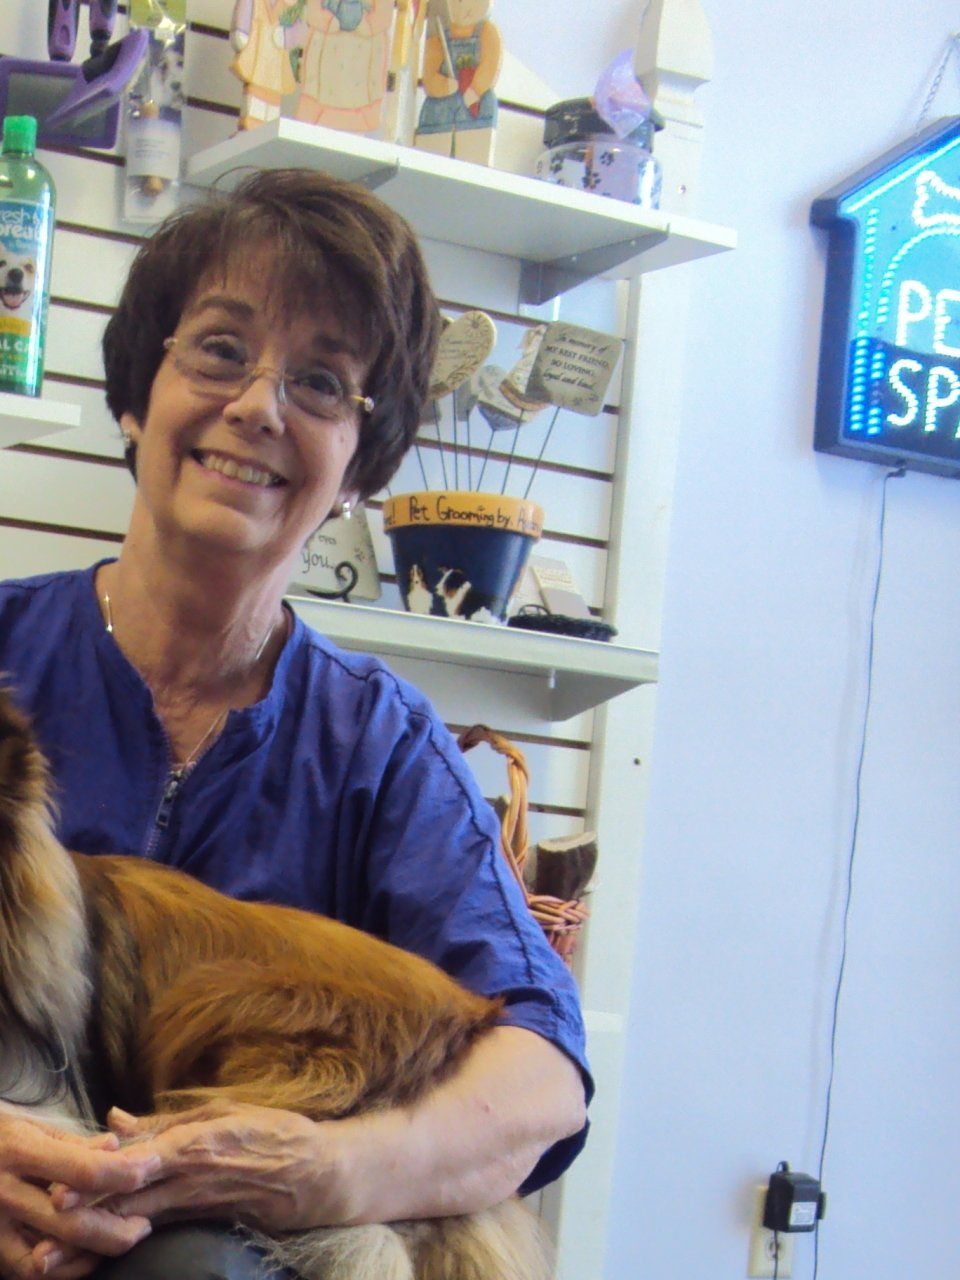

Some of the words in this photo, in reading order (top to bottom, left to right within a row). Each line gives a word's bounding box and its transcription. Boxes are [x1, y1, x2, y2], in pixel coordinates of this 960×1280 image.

[559, 348, 577, 358] BEST
[888, 360, 960, 439] SP
[408, 496, 433, 522] Pet
[436, 495, 496, 527] Grooming
